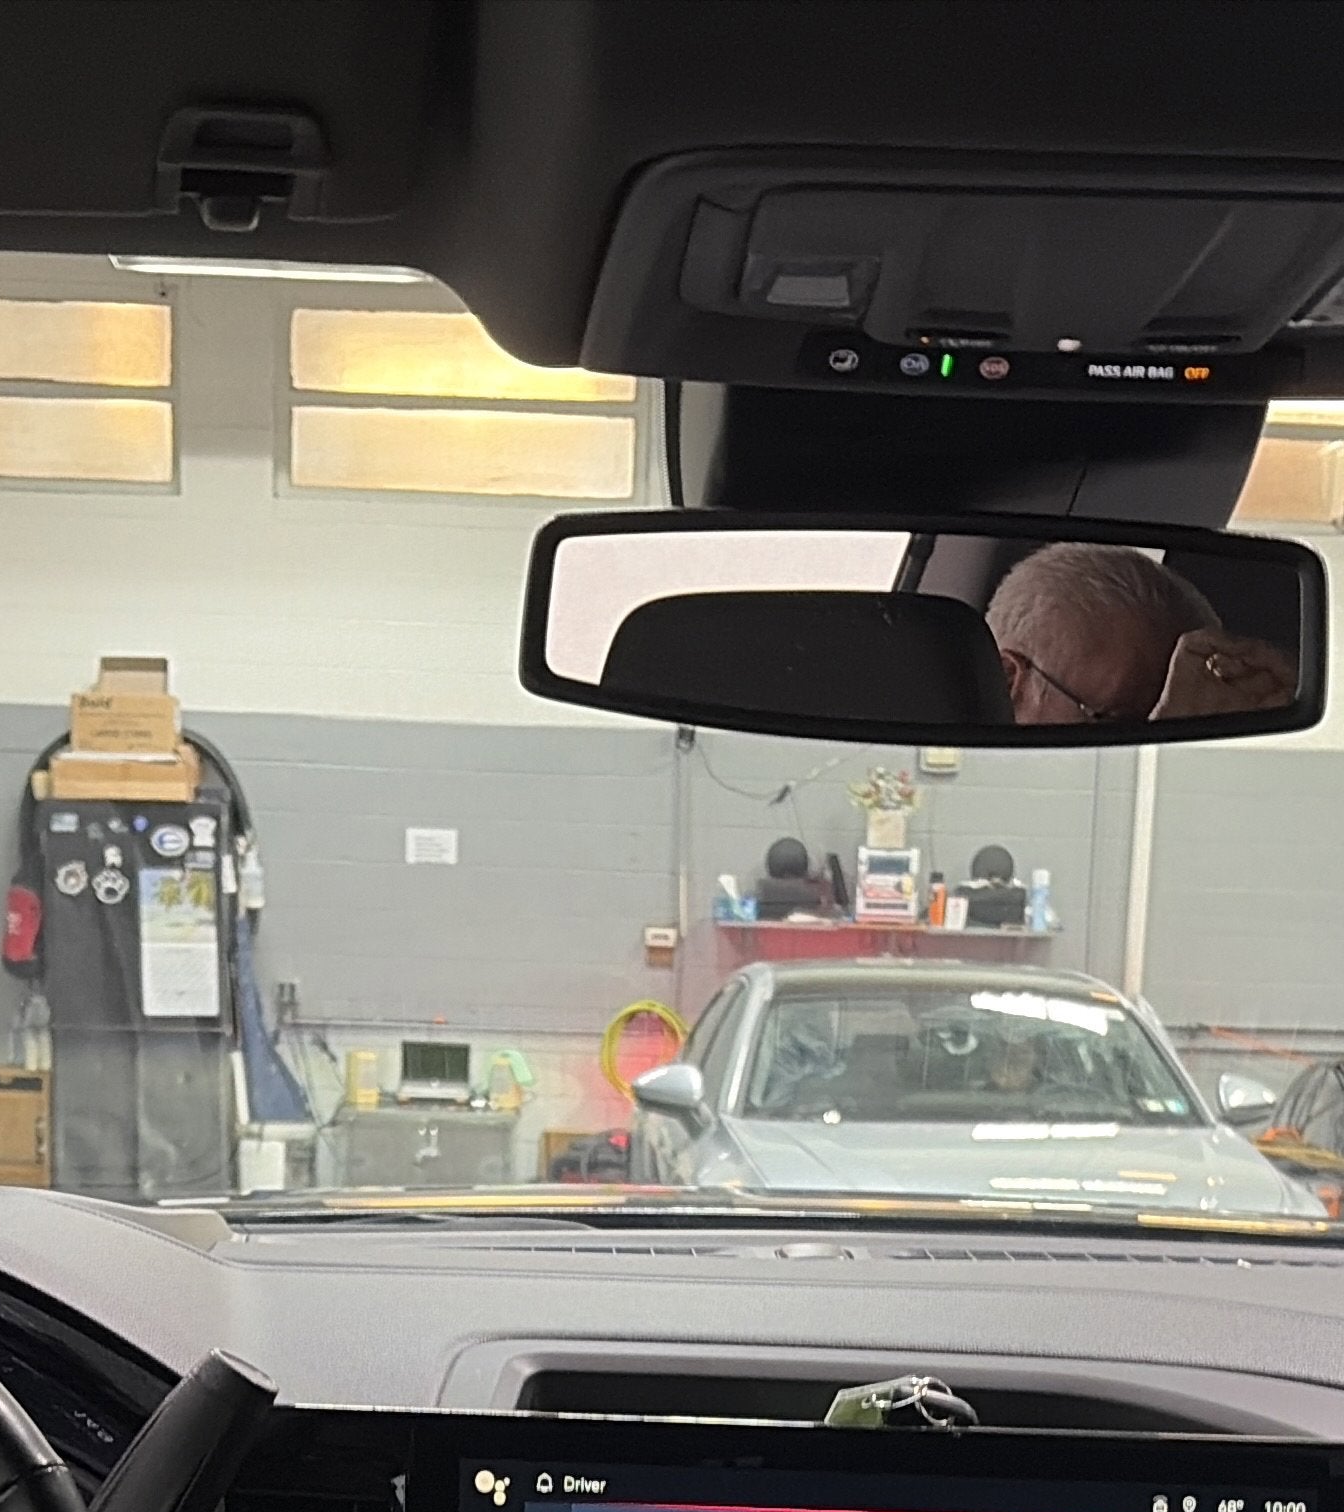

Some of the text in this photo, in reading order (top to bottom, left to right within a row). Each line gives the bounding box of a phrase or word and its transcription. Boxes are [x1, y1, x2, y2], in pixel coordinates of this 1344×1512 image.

[1088, 364, 1210, 380] PASS AIR BAG OFF
[563, 1475, 606, 1494] Driver
